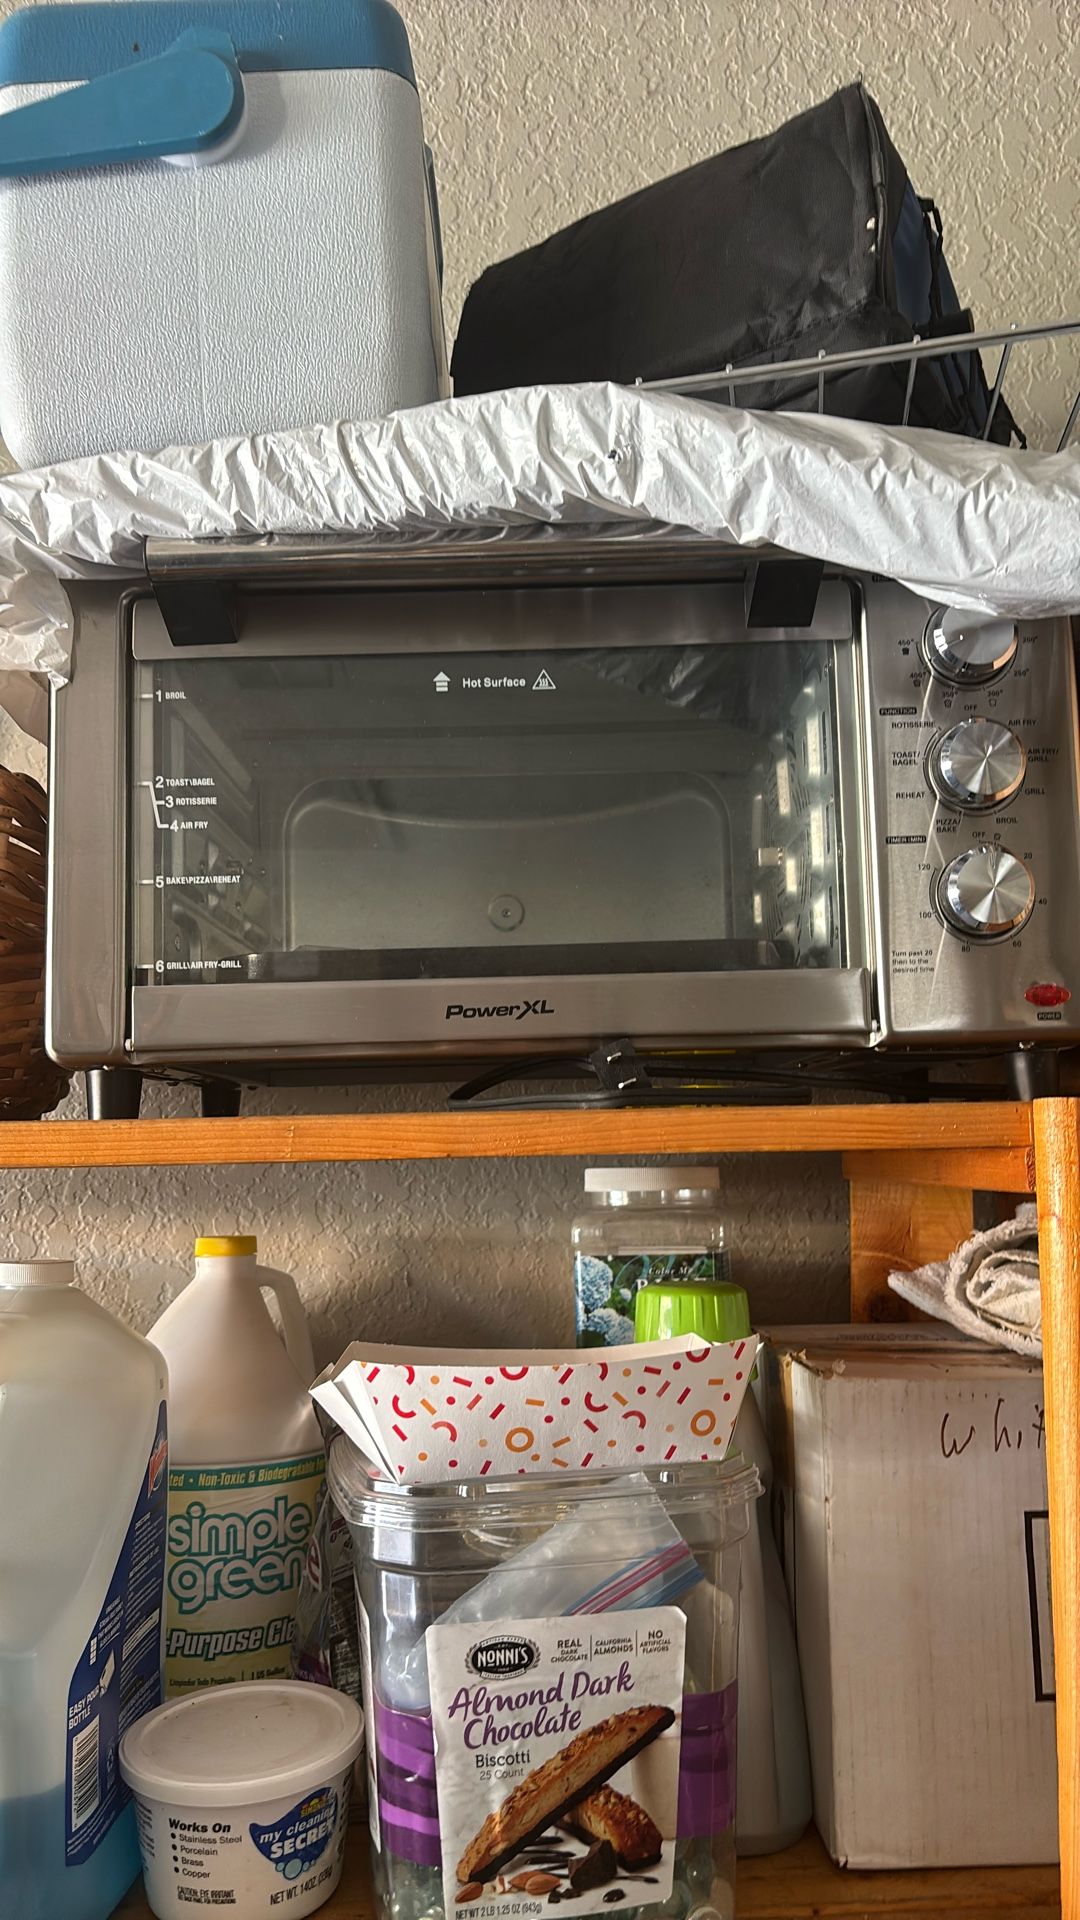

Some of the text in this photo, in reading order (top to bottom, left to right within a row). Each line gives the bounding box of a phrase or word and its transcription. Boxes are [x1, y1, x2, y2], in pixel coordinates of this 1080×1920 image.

[462, 676, 526, 688] Hot Surface
[156, 689, 186, 702] 1 BROIL
[892, 751, 921, 759] TOAST/
[155, 776, 164, 788] 2
[165, 795, 217, 808] 3 ROTISSERIE
[170, 820, 208, 832] 4 AIR FRY
[936, 818, 961, 826] PIZZA/
[1023, 852, 1033, 860] 20
[155, 875, 164, 888] 5
[919, 911, 932, 919] 100
[961, 945, 971, 953] 80
[1012, 940, 1022, 948] 60
[155, 960, 164, 973] 6
[204, 960, 242, 969] FRY-GRILL
[445, 999, 555, 1020] PowerXL
[198, 1471, 246, 1487] Non-Toxic
[249, 1471, 256, 1483] &
[168, 1496, 313, 1559] simple
[168, 1543, 307, 1615] green
[648, 1629, 663, 1640] NO
[557, 1638, 582, 1649] REAL
[595, 1638, 632, 1646] CALIFORNIA
[640, 1638, 671, 1648] ARTIFICIAL
[593, 1644, 634, 1655] ALMONDS
[642, 1646, 669, 1654] FLAVORS
[477, 1647, 529, 1668] NONNI'S
[550, 1654, 588, 1663] CHOCOLATE
[448, 1660, 635, 1722] Almond Dark
[68, 1684, 100, 1718] EASY POUR
[68, 1704, 91, 1730] BOTTLE
[463, 1703, 582, 1750] Chocolate
[475, 1750, 531, 1769] Biscotti
[479, 1768, 524, 1782] 25 Count
[168, 1817, 231, 1833] Works On
[259, 1828, 283, 1845] my
[286, 1802, 336, 1837] cleaning
[179, 1833, 243, 1844] Stainless Steel
[270, 1815, 336, 1860] SECRET
[180, 1845, 218, 1856] Porcelain
[181, 1856, 204, 1867] Brass
[182, 1868, 211, 1879] Copper
[270, 1890, 285, 1905] NET
[456, 1909, 467, 1919] NET
[469, 1908, 479, 1918] WT
[481, 1907, 486, 1917] 2
[486, 1906, 495, 1916] LB
[497, 1904, 511, 1915] 1.25
[511, 1903, 521, 1914] OZ
